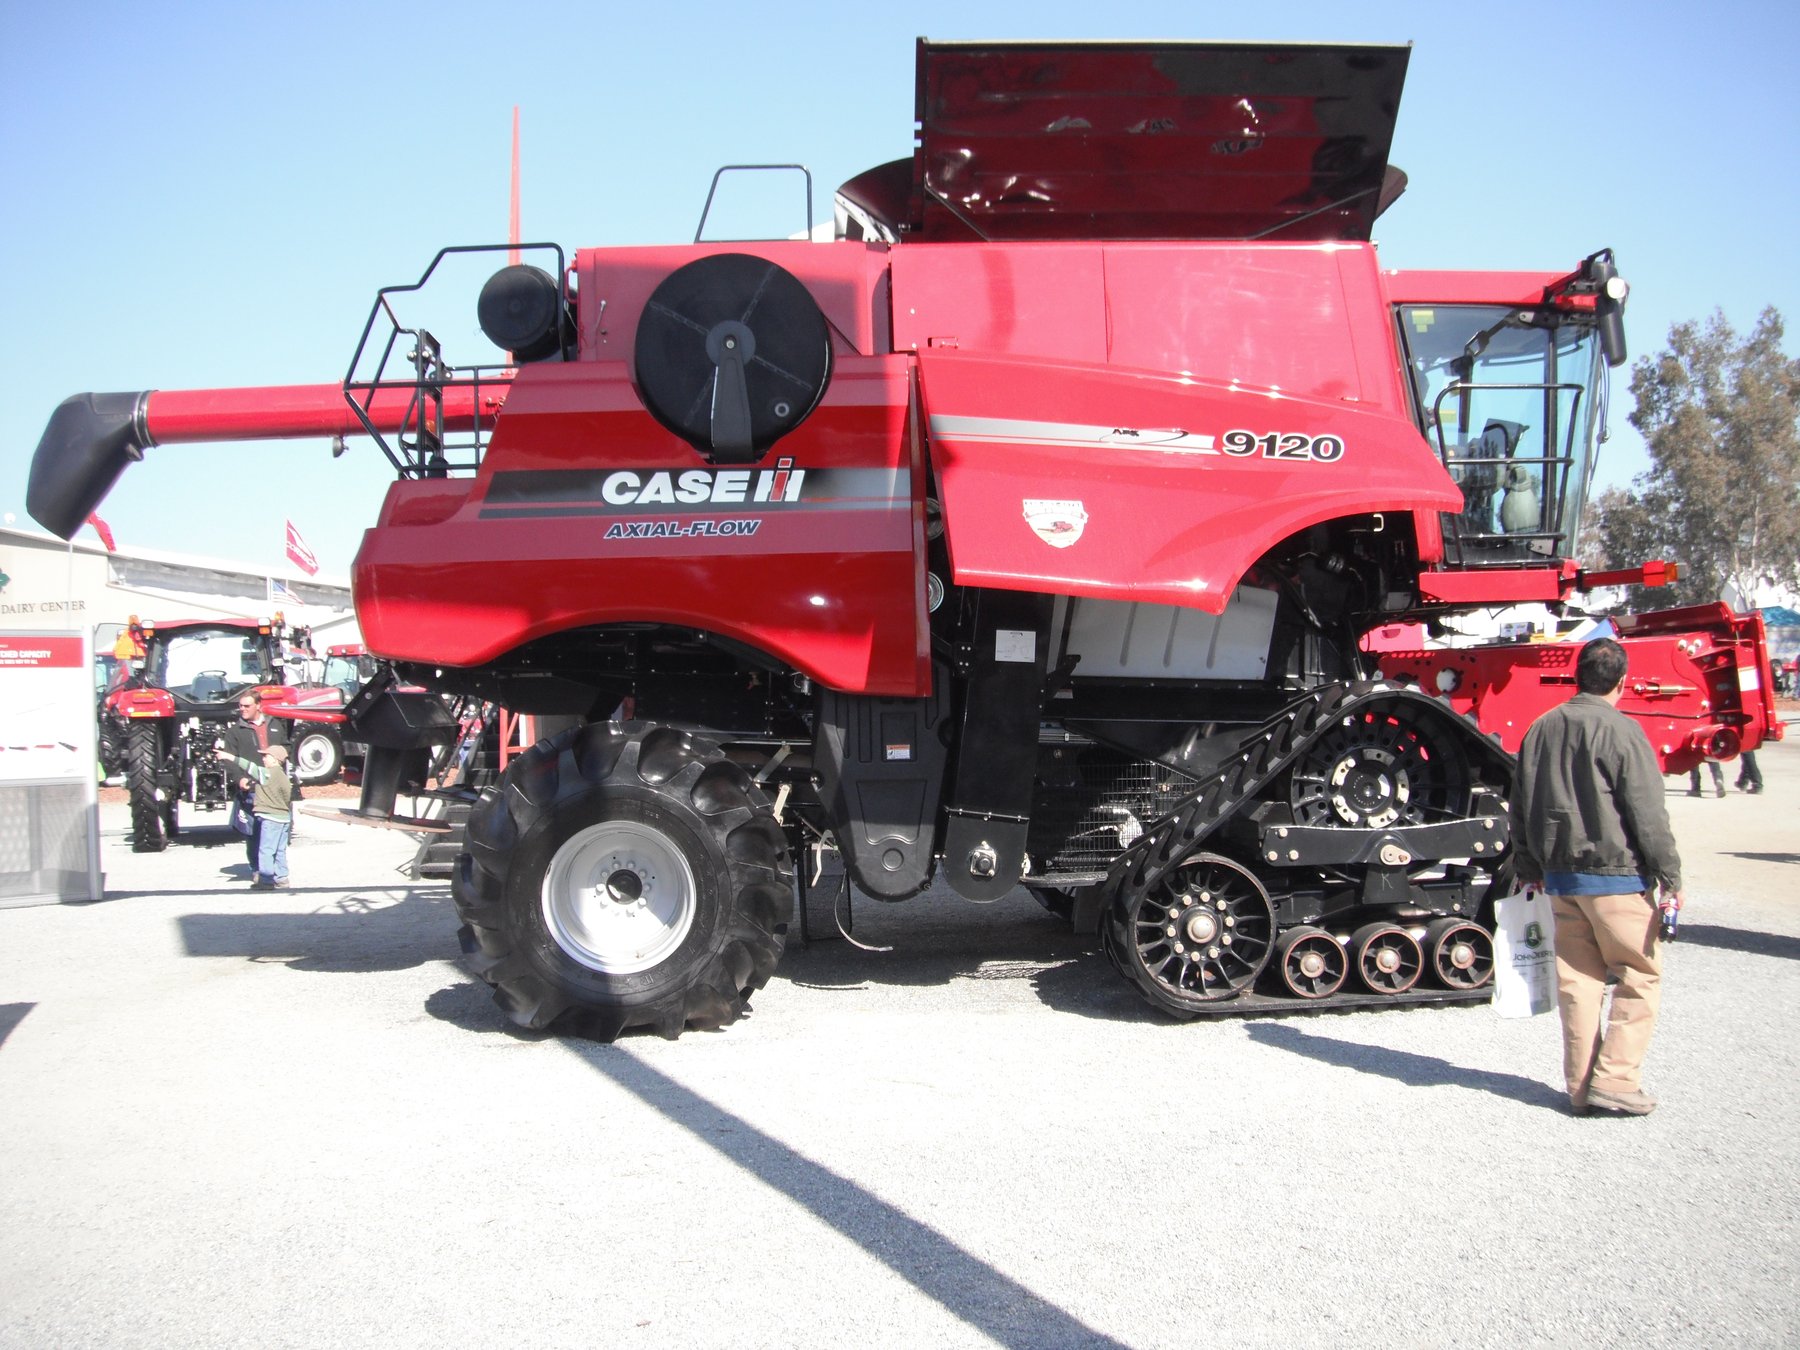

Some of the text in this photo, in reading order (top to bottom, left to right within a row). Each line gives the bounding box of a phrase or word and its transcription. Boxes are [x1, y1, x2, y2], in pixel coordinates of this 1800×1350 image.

[1222, 430, 1345, 462] 9120
[602, 470, 751, 505] CASE
[603, 520, 762, 539] AXIAL-FLOW
[1, 600, 86, 614] DAIRY CENTER
